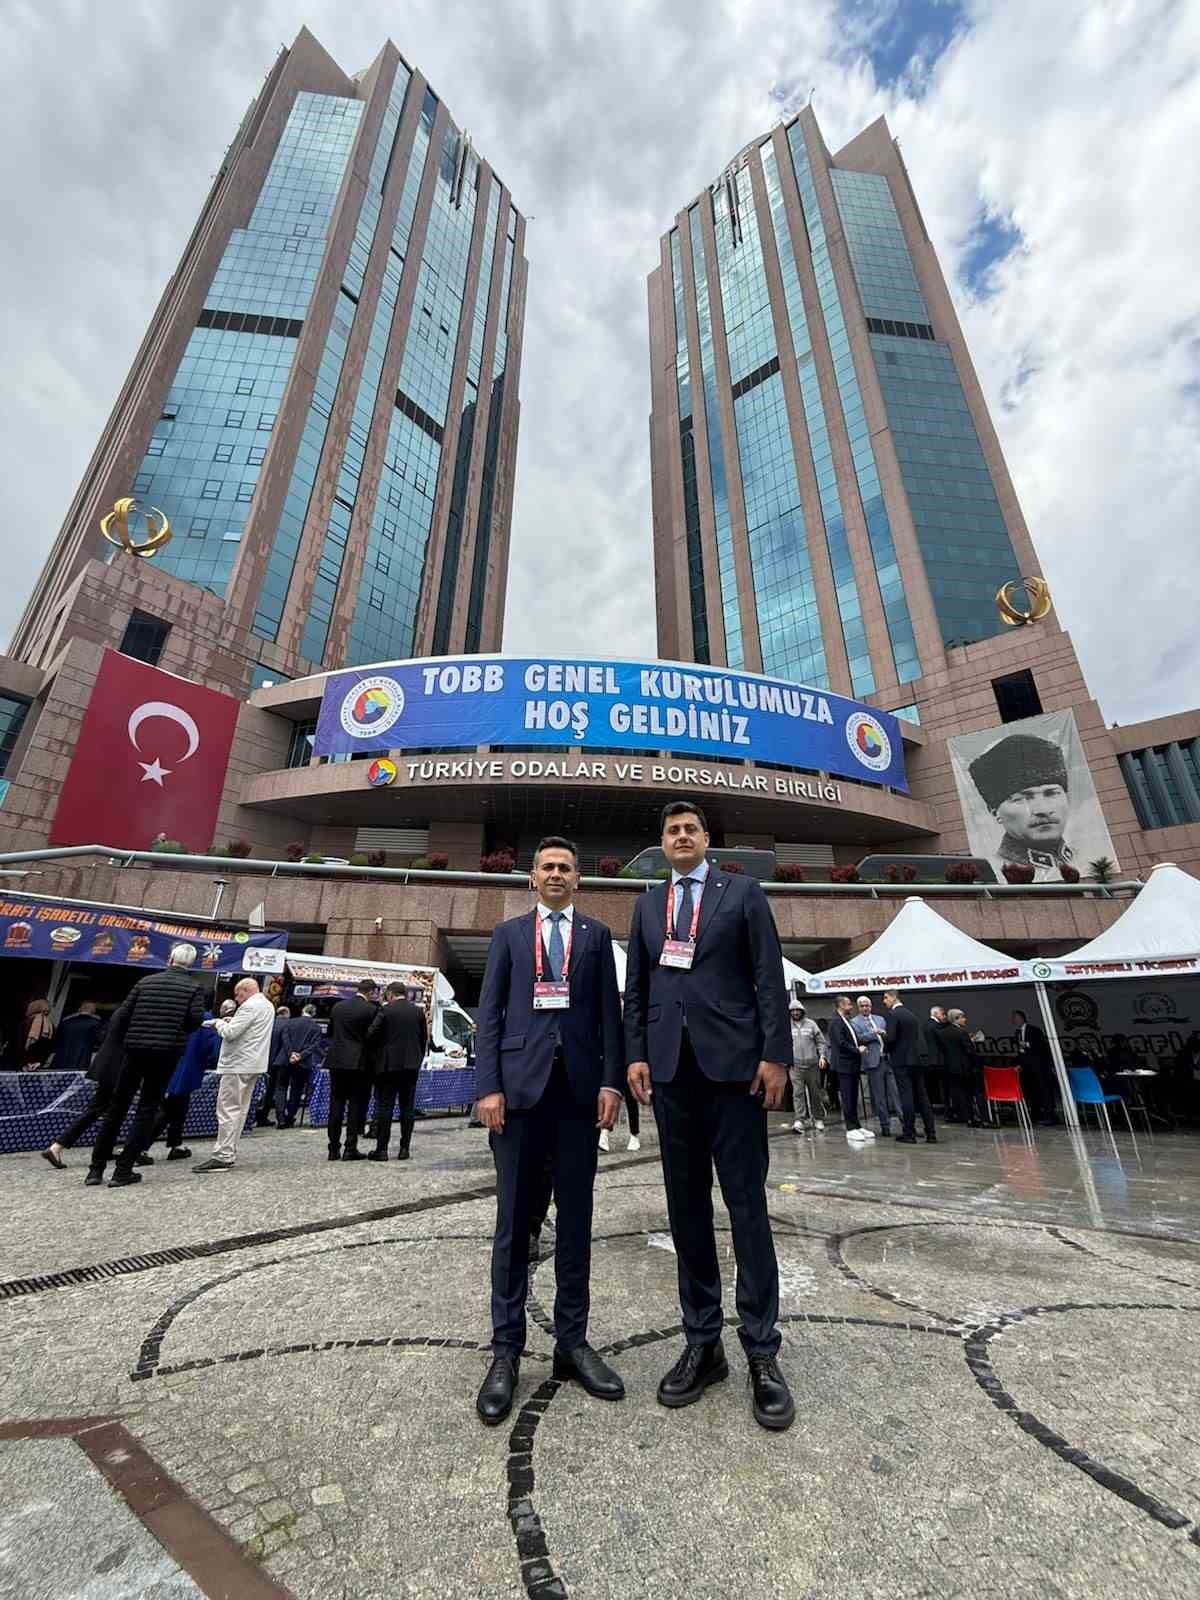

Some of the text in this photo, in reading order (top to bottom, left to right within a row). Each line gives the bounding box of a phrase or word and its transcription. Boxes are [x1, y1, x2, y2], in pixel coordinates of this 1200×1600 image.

[423, 664, 834, 725] TOBB GENEL KURULUMUZA
[524, 700, 750, 745] HOŞ GELDİNİZ
[407, 758, 842, 803] TÜRKİYE ODALAR VE BORSALAR BİRLİĞİ
